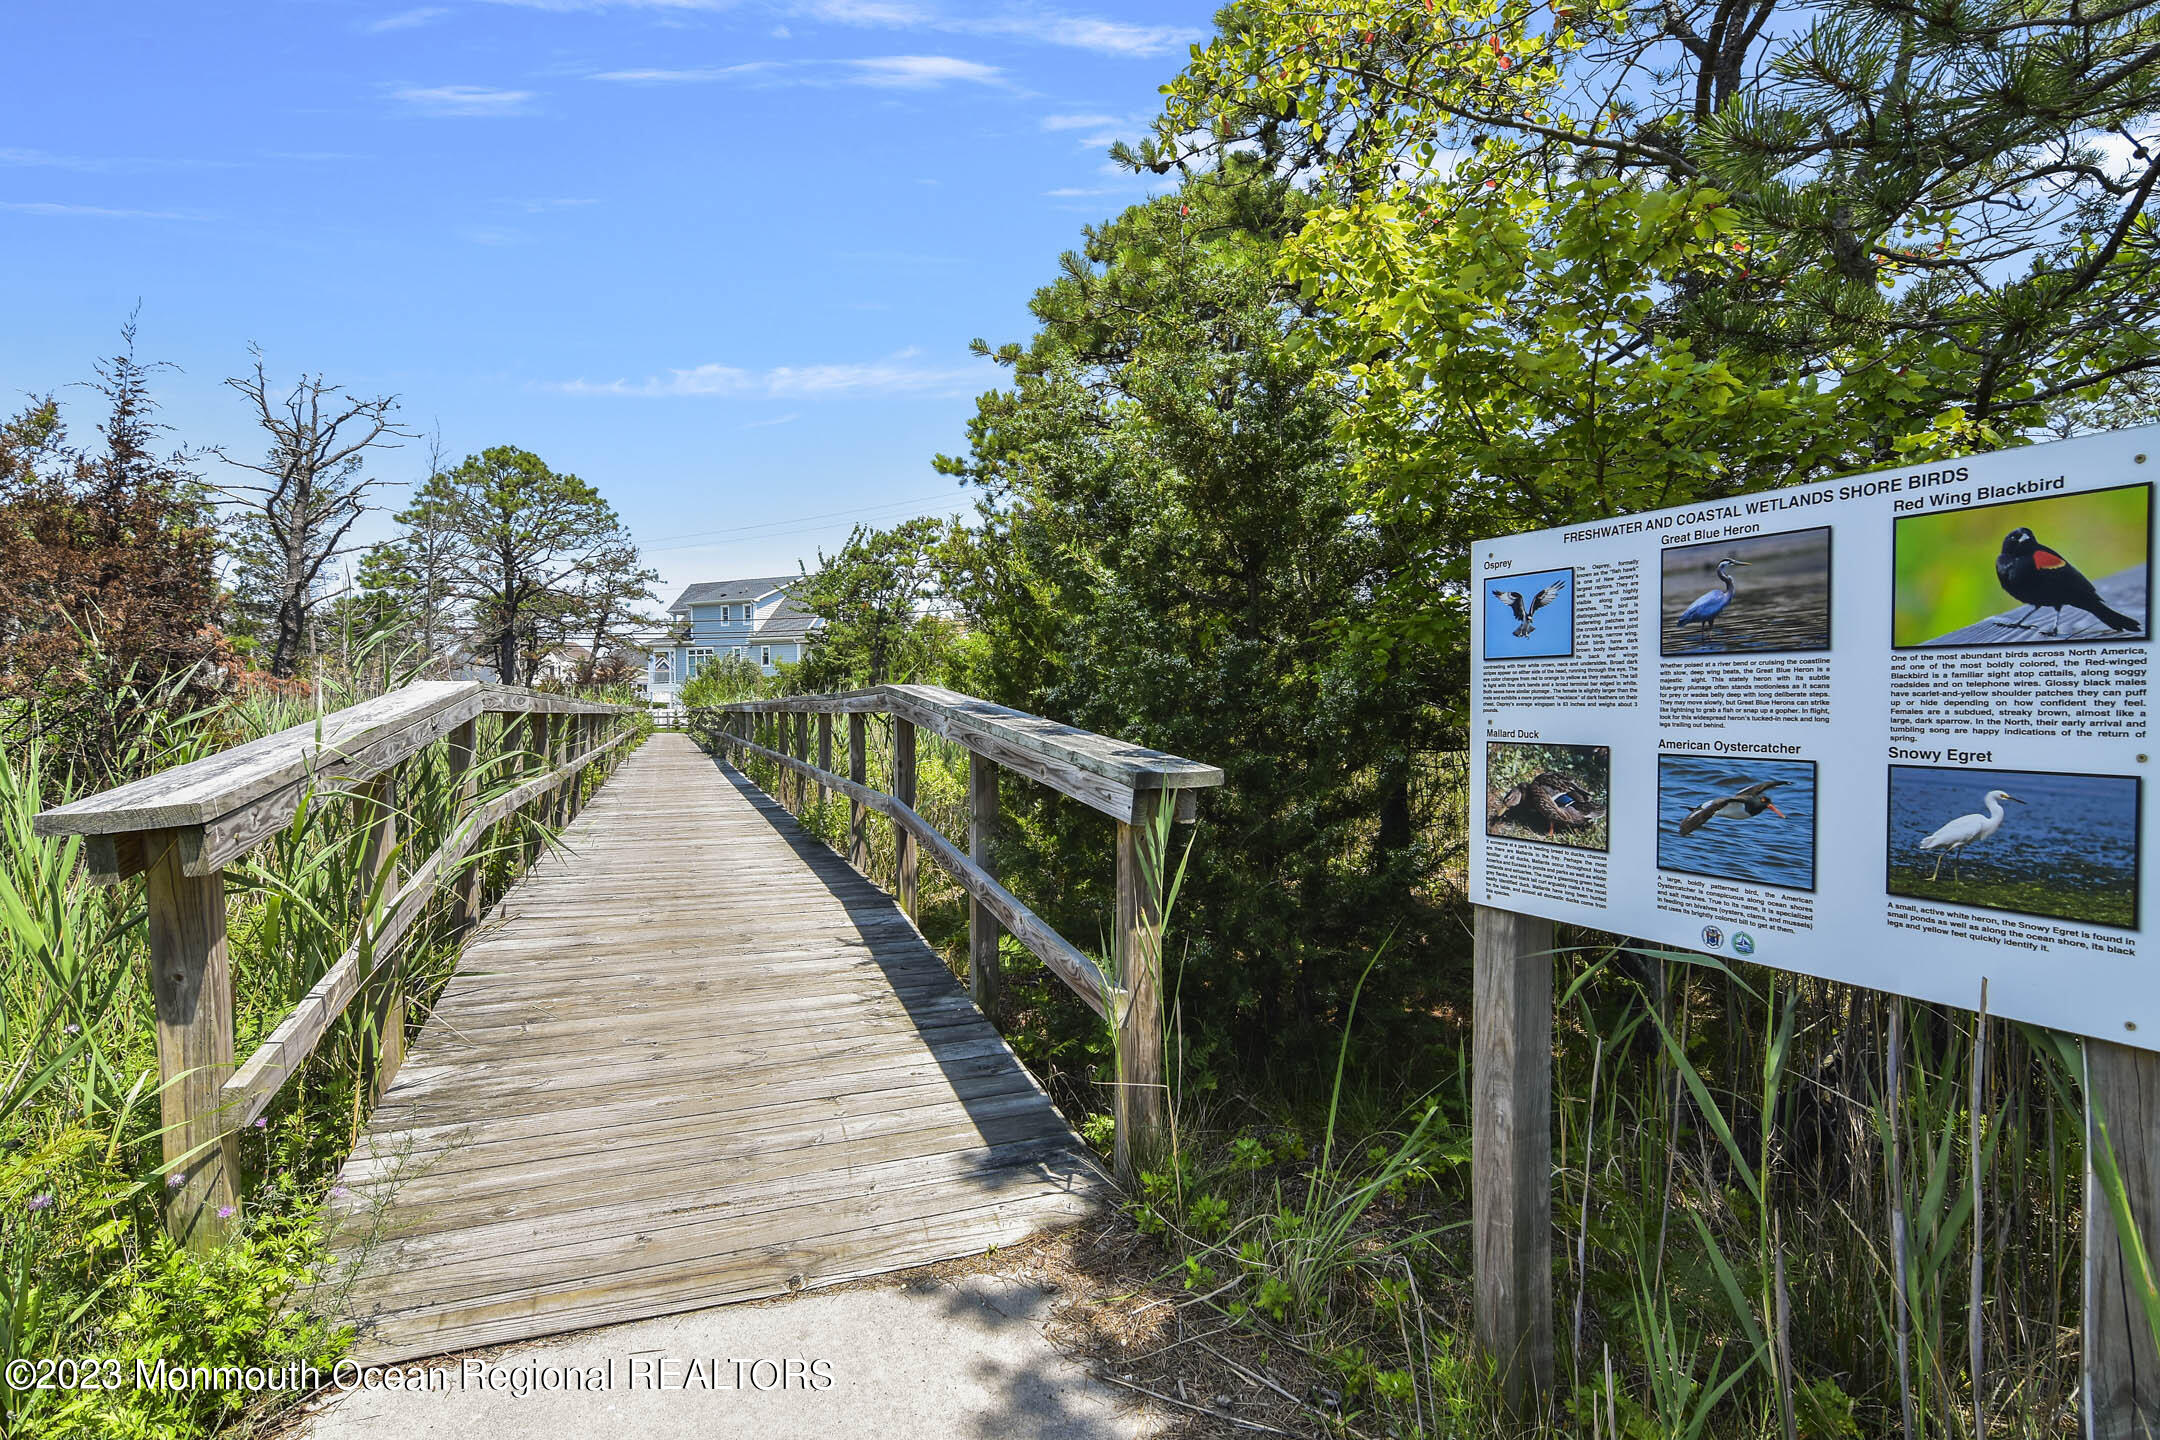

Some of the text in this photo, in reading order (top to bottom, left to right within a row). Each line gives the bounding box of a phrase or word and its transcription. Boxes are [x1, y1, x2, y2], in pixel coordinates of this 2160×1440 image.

[1894, 476, 2065, 512] Red Wing Blackbird
[1563, 467, 1969, 543] FRESHWATER AND COASTAL WETLANDS SHORE BIRDS
[1661, 524, 1760, 544] Great Blue Heron
[1484, 560, 1512, 570] Osprey
[1961, 651, 2002, 660] abundant
[2006, 650, 2028, 658] birds
[2069, 648, 2096, 656] North
[2101, 646, 2147, 655] America,
[1684, 661, 1703, 669] poised
[1759, 658, 1784, 666] cruising
[1987, 660, 2014, 670] boldly
[2020, 659, 2058, 668] colored,
[2064, 658, 2079, 666] the
[2086, 656, 2147, 667] Red-winged
[1952, 670, 1983, 678] familiar
[1988, 670, 2010, 679] sight
[2014, 670, 2034, 679] atop
[2039, 668, 2076, 677] cattails,
[2081, 668, 2109, 678] along
[2114, 668, 2146, 677] soggy
[1966, 680, 2010, 689] telephone
[2045, 679, 2079, 688] Glossy
[2084, 678, 2111, 686] black
[2115, 678, 2146, 686] males
[1912, 689, 1988, 699] scarlet-and-yellow
[2036, 688, 2073, 698] patches
[2077, 688, 2099, 698] they
[2126, 688, 2147, 698] puff
[1944, 698, 1989, 708] depending
[2040, 698, 2086, 706] confident
[2094, 698, 2116, 708] they
[2124, 698, 2146, 707] feel.
[1954, 708, 1994, 716] subdued,
[1999, 708, 2032, 718] streaky
[2038, 708, 2070, 717] brown,
[2076, 708, 2110, 717] almost
[2116, 708, 2134, 717] like
[1891, 716, 1912, 726] large,
[2005, 718, 2032, 727] North,
[2037, 718, 2058, 726] their
[2062, 718, 2086, 728] early
[2090, 719, 2122, 727] arrival
[2126, 719, 2146, 728] and
[1486, 728, 1540, 738] Mallard Duck
[1890, 726, 1925, 735] tumbling
[1973, 727, 1999, 736] happy
[2005, 727, 2056, 736] indications
[2061, 728, 2071, 736] of
[2077, 728, 2092, 737] the
[2135, 730, 2146, 738] of
[1890, 734, 1917, 744] spring.
[1658, 739, 1801, 754] American Oystercatcher
[1888, 746, 1992, 764] Snowy Egret
[1667, 876, 1682, 884] large,
[1688, 879, 1705, 889] boldly
[1711, 884, 1739, 893] patterned
[1745, 888, 1759, 897] bird,
[1782, 894, 1813, 904] American
[1896, 904, 1918, 913] small,
[1921, 908, 1944, 916] active
[1947, 911, 1969, 920] white
[1972, 914, 1999, 926] heron,
[2002, 919, 2016, 927] the
[2019, 921, 2050, 934] Snowy
[2053, 926, 2078, 937] Egret
[2082, 930, 2090, 939] is
[2093, 932, 2122, 944] found
[2126, 937, 2135, 946] in
[1887, 918, 1903, 928] legs
[1923, 926, 1948, 935] yellow
[1952, 929, 1967, 938] feet
[1970, 933, 2001, 946] quickly
[2004, 937, 2038, 952] identify
[1888, 911, 1908, 920] small
[1910, 915, 1935, 924] ponds
[1982, 925, 2006, 937] along
[2009, 929, 2023, 938] the
[2026, 933, 2054, 943] ocean
[2058, 937, 2088, 950] shore,
[2092, 942, 2104, 951] its
[2107, 944, 2135, 956] black
